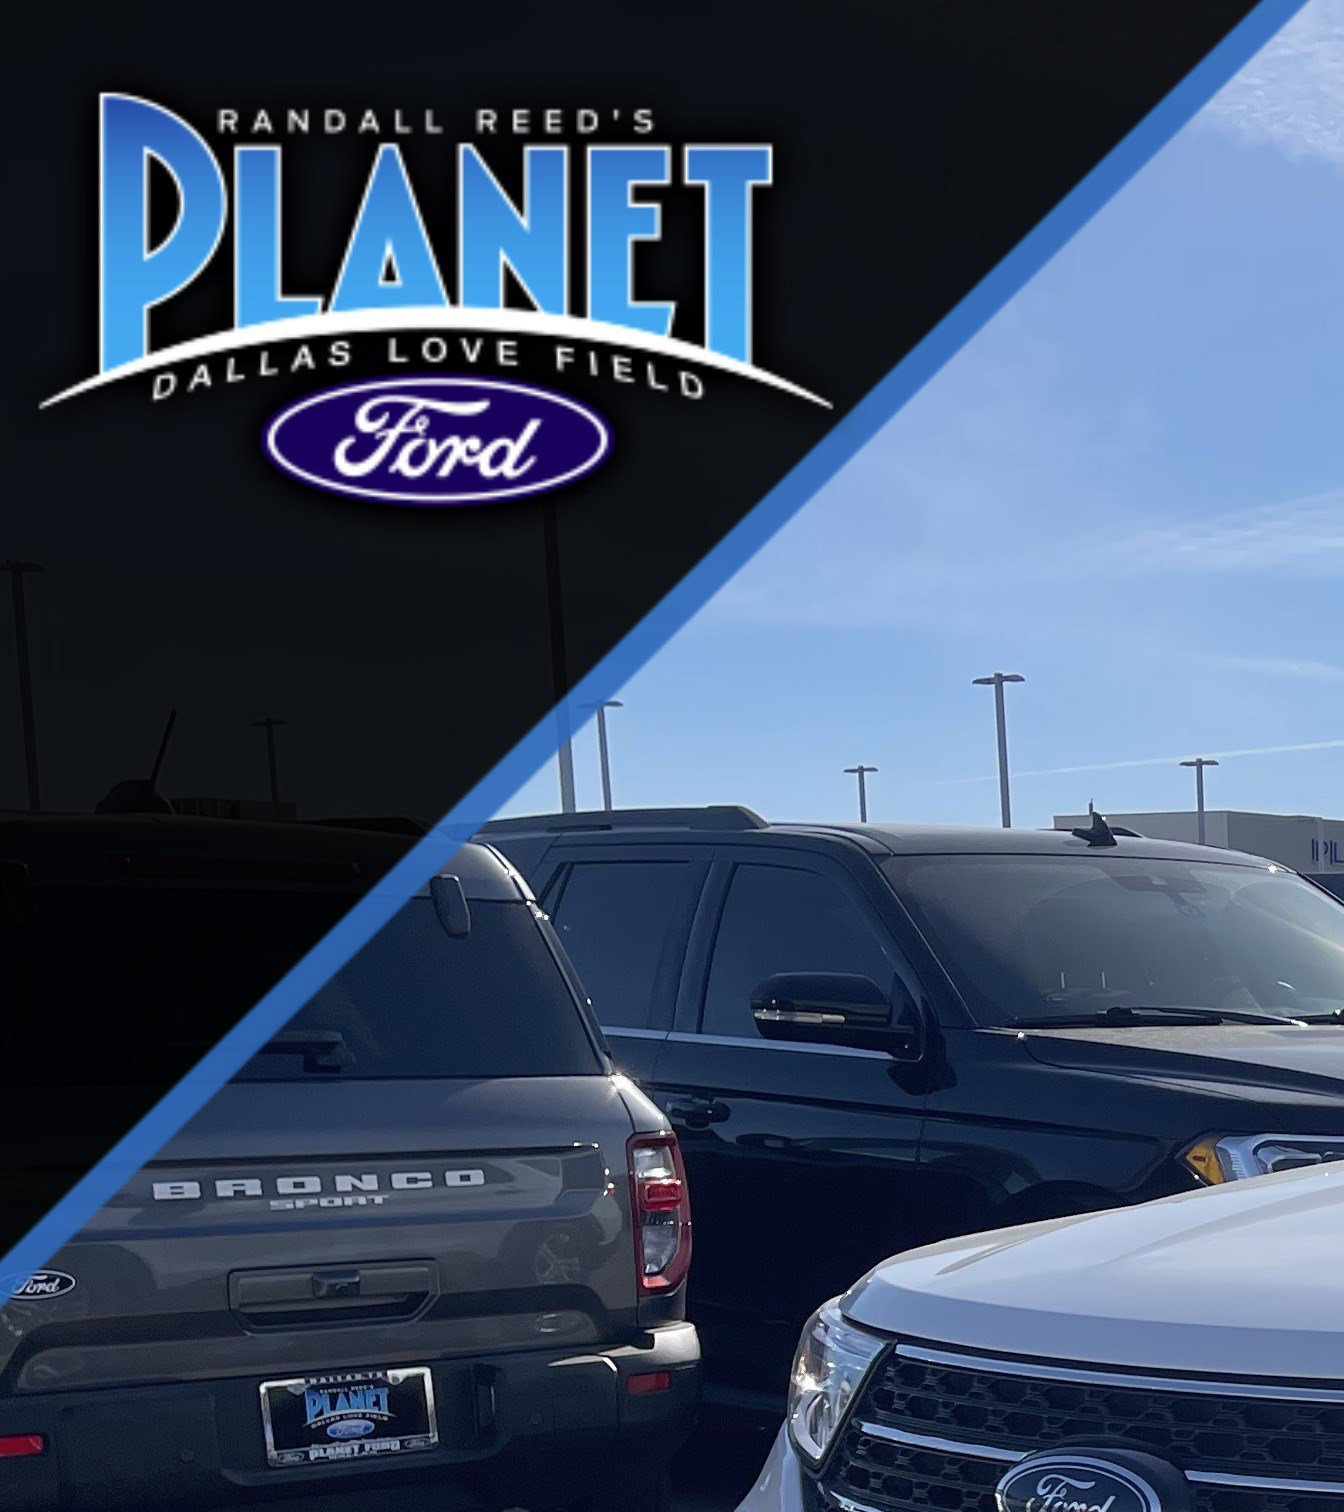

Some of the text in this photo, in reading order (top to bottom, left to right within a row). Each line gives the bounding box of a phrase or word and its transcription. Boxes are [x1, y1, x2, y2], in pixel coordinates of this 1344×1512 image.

[152, 1168, 486, 1200] BRONCO
[269, 1194, 390, 1211] SPORT
[12, 1274, 61, 1295] Ford
[305, 1386, 390, 1425] PLANET
